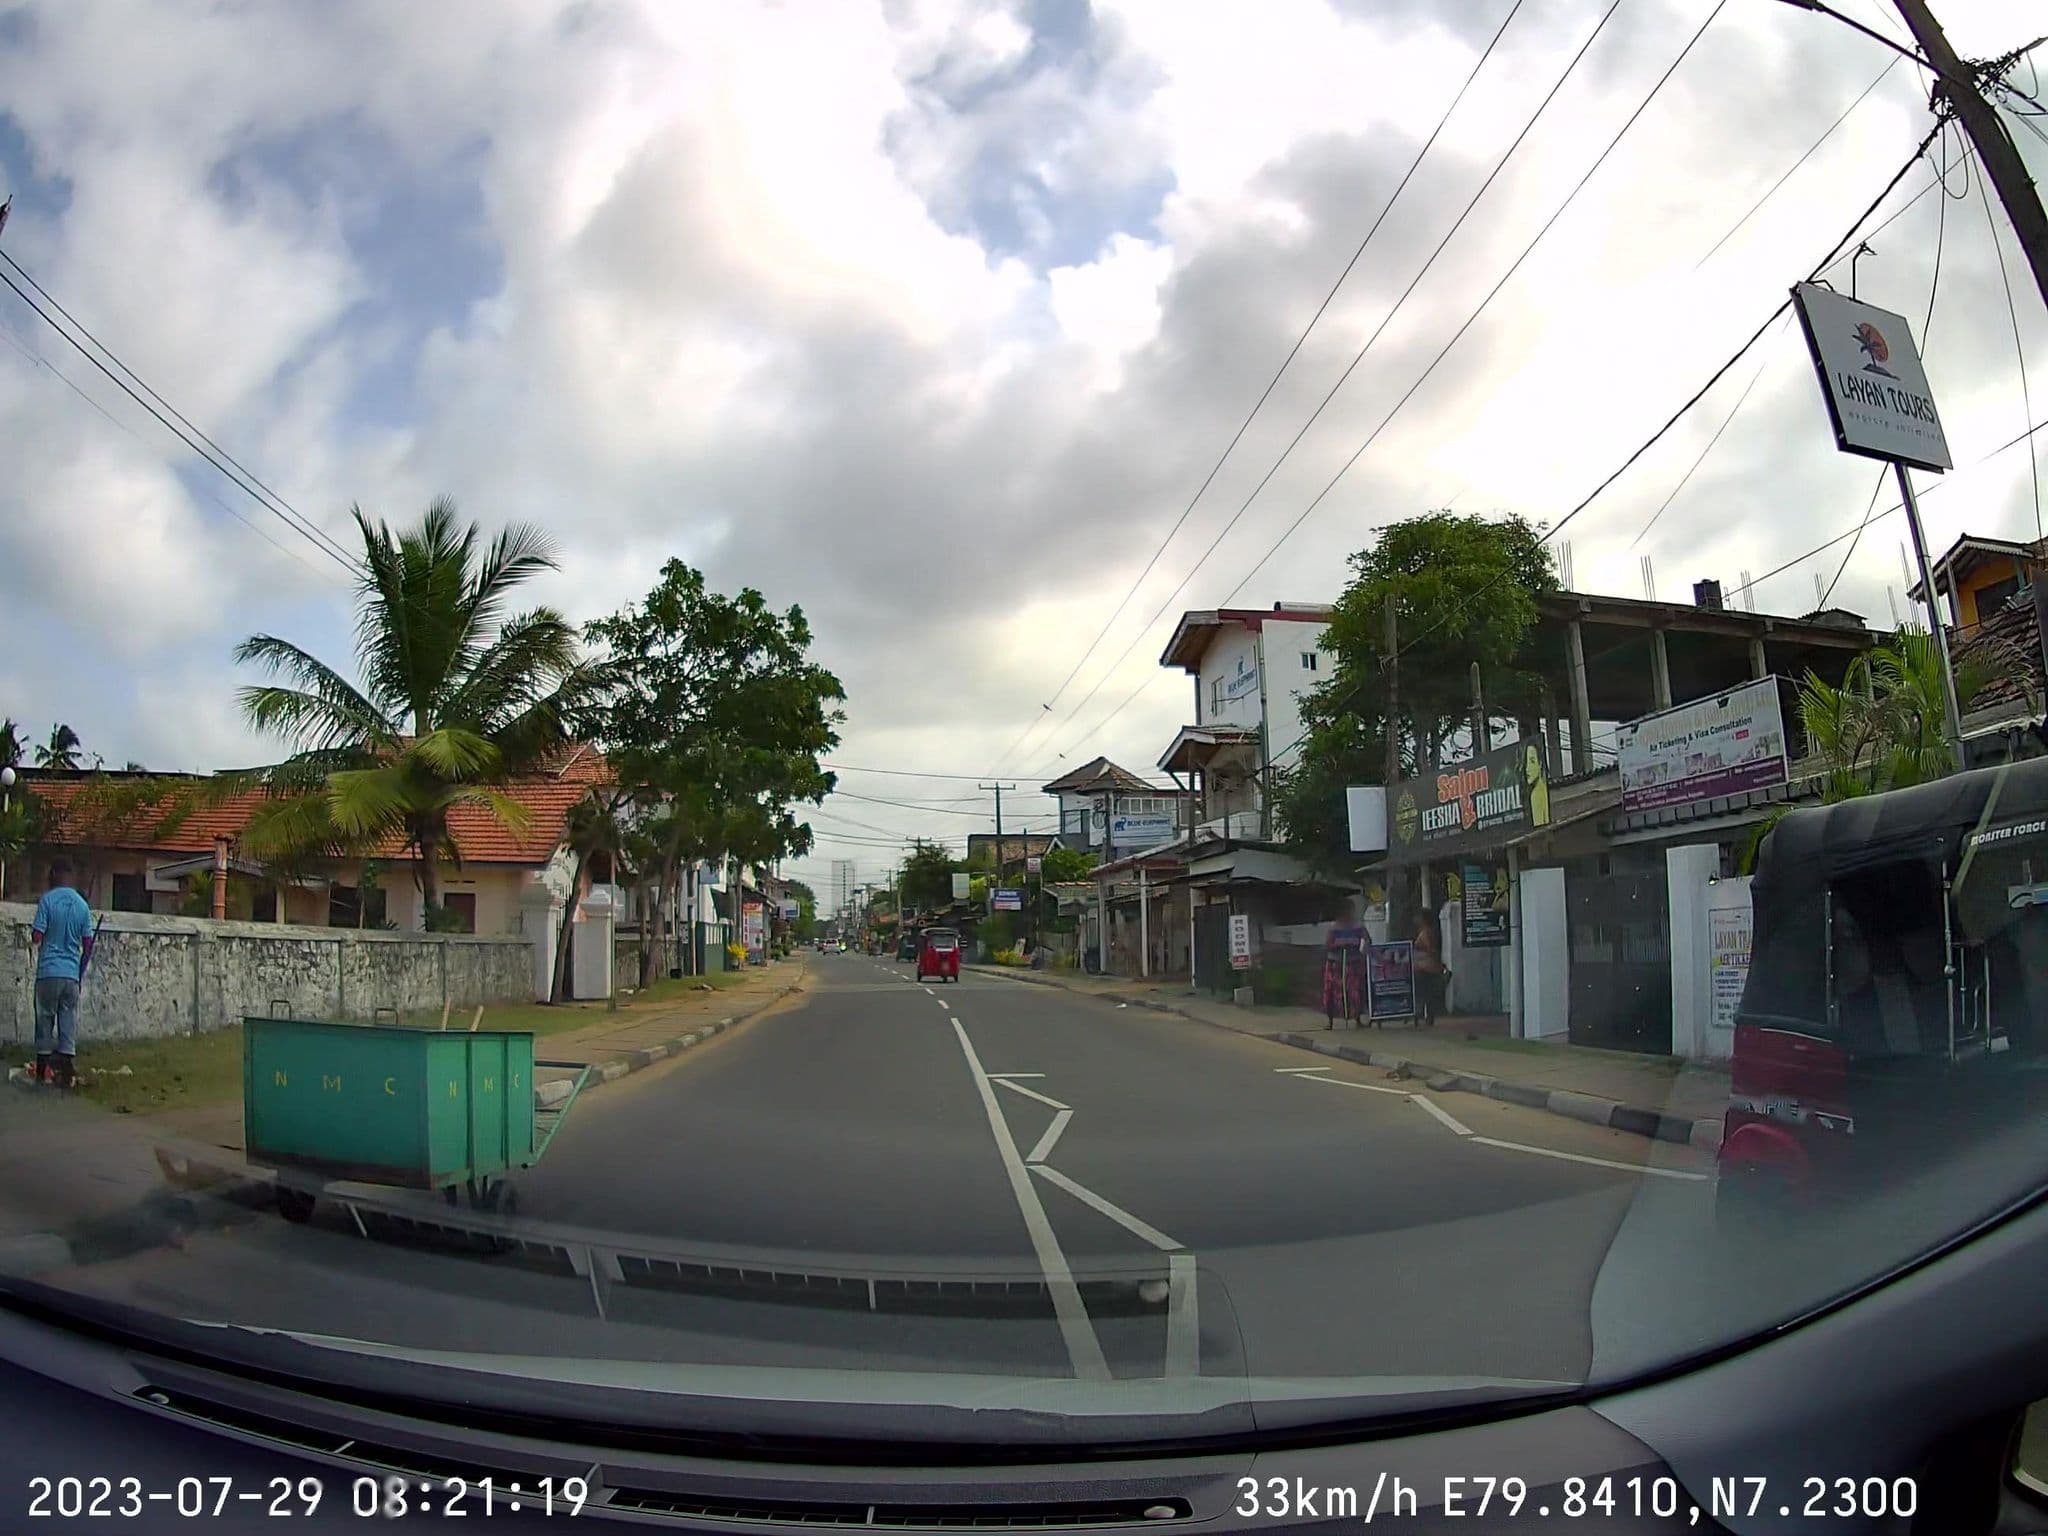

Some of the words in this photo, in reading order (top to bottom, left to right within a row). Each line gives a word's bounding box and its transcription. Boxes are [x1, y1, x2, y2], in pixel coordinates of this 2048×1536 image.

[1837, 372, 1888, 410] LAYAN
[1887, 386, 1935, 424] TOURS
[1658, 734, 1688, 749] Ticketing
[1710, 715, 1753, 735] Consultation
[1437, 765, 1489, 804] Salon
[1476, 784, 1524, 819] BRIDAL
[1970, 827, 2012, 846] MONSTER
[2013, 821, 2046, 837] FORCE
